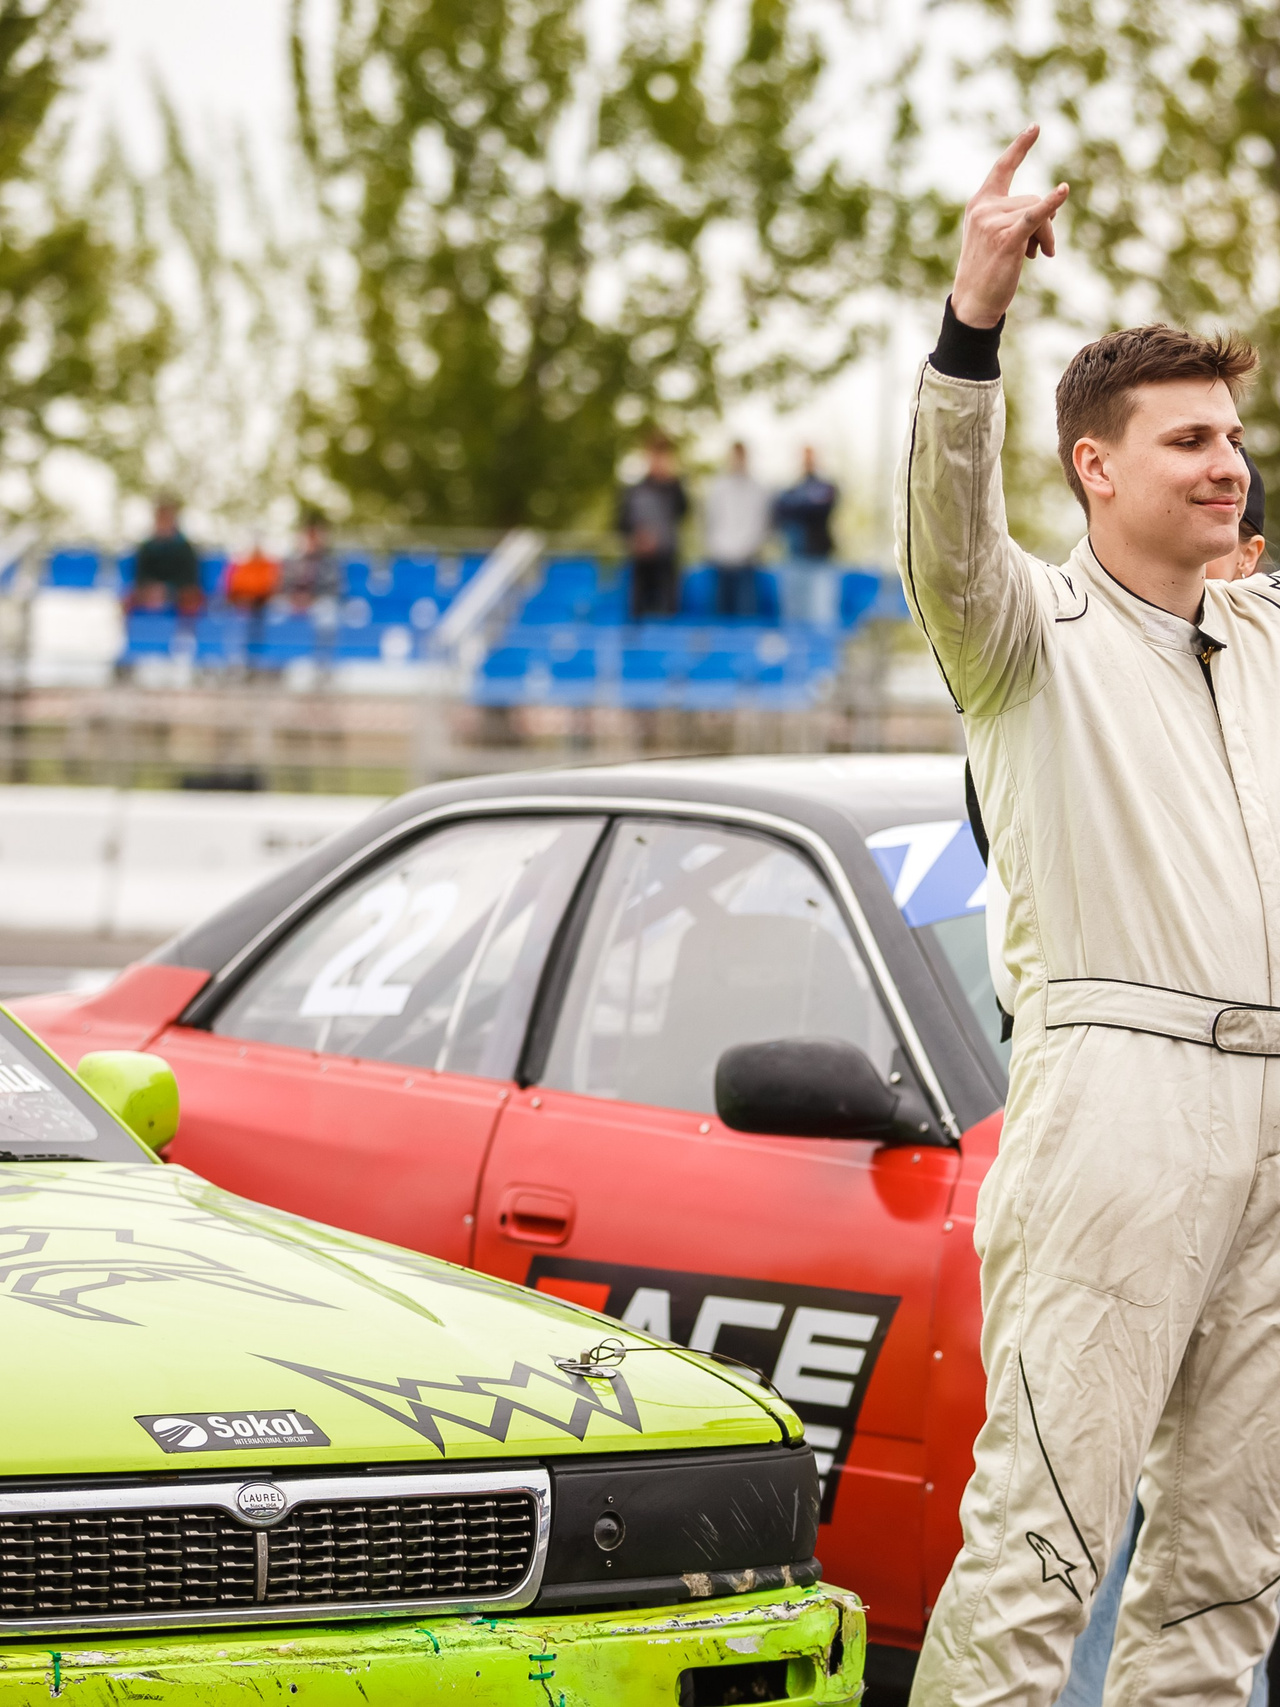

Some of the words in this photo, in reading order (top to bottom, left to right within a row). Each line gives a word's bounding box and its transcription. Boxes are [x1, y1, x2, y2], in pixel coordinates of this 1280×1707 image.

[300, 878, 459, 1017] 22
[233, 1435, 281, 1446] INTERNATIONAL
[282, 1435, 309, 1444] CIRCUIT
[243, 1492, 283, 1503] LAUREL
